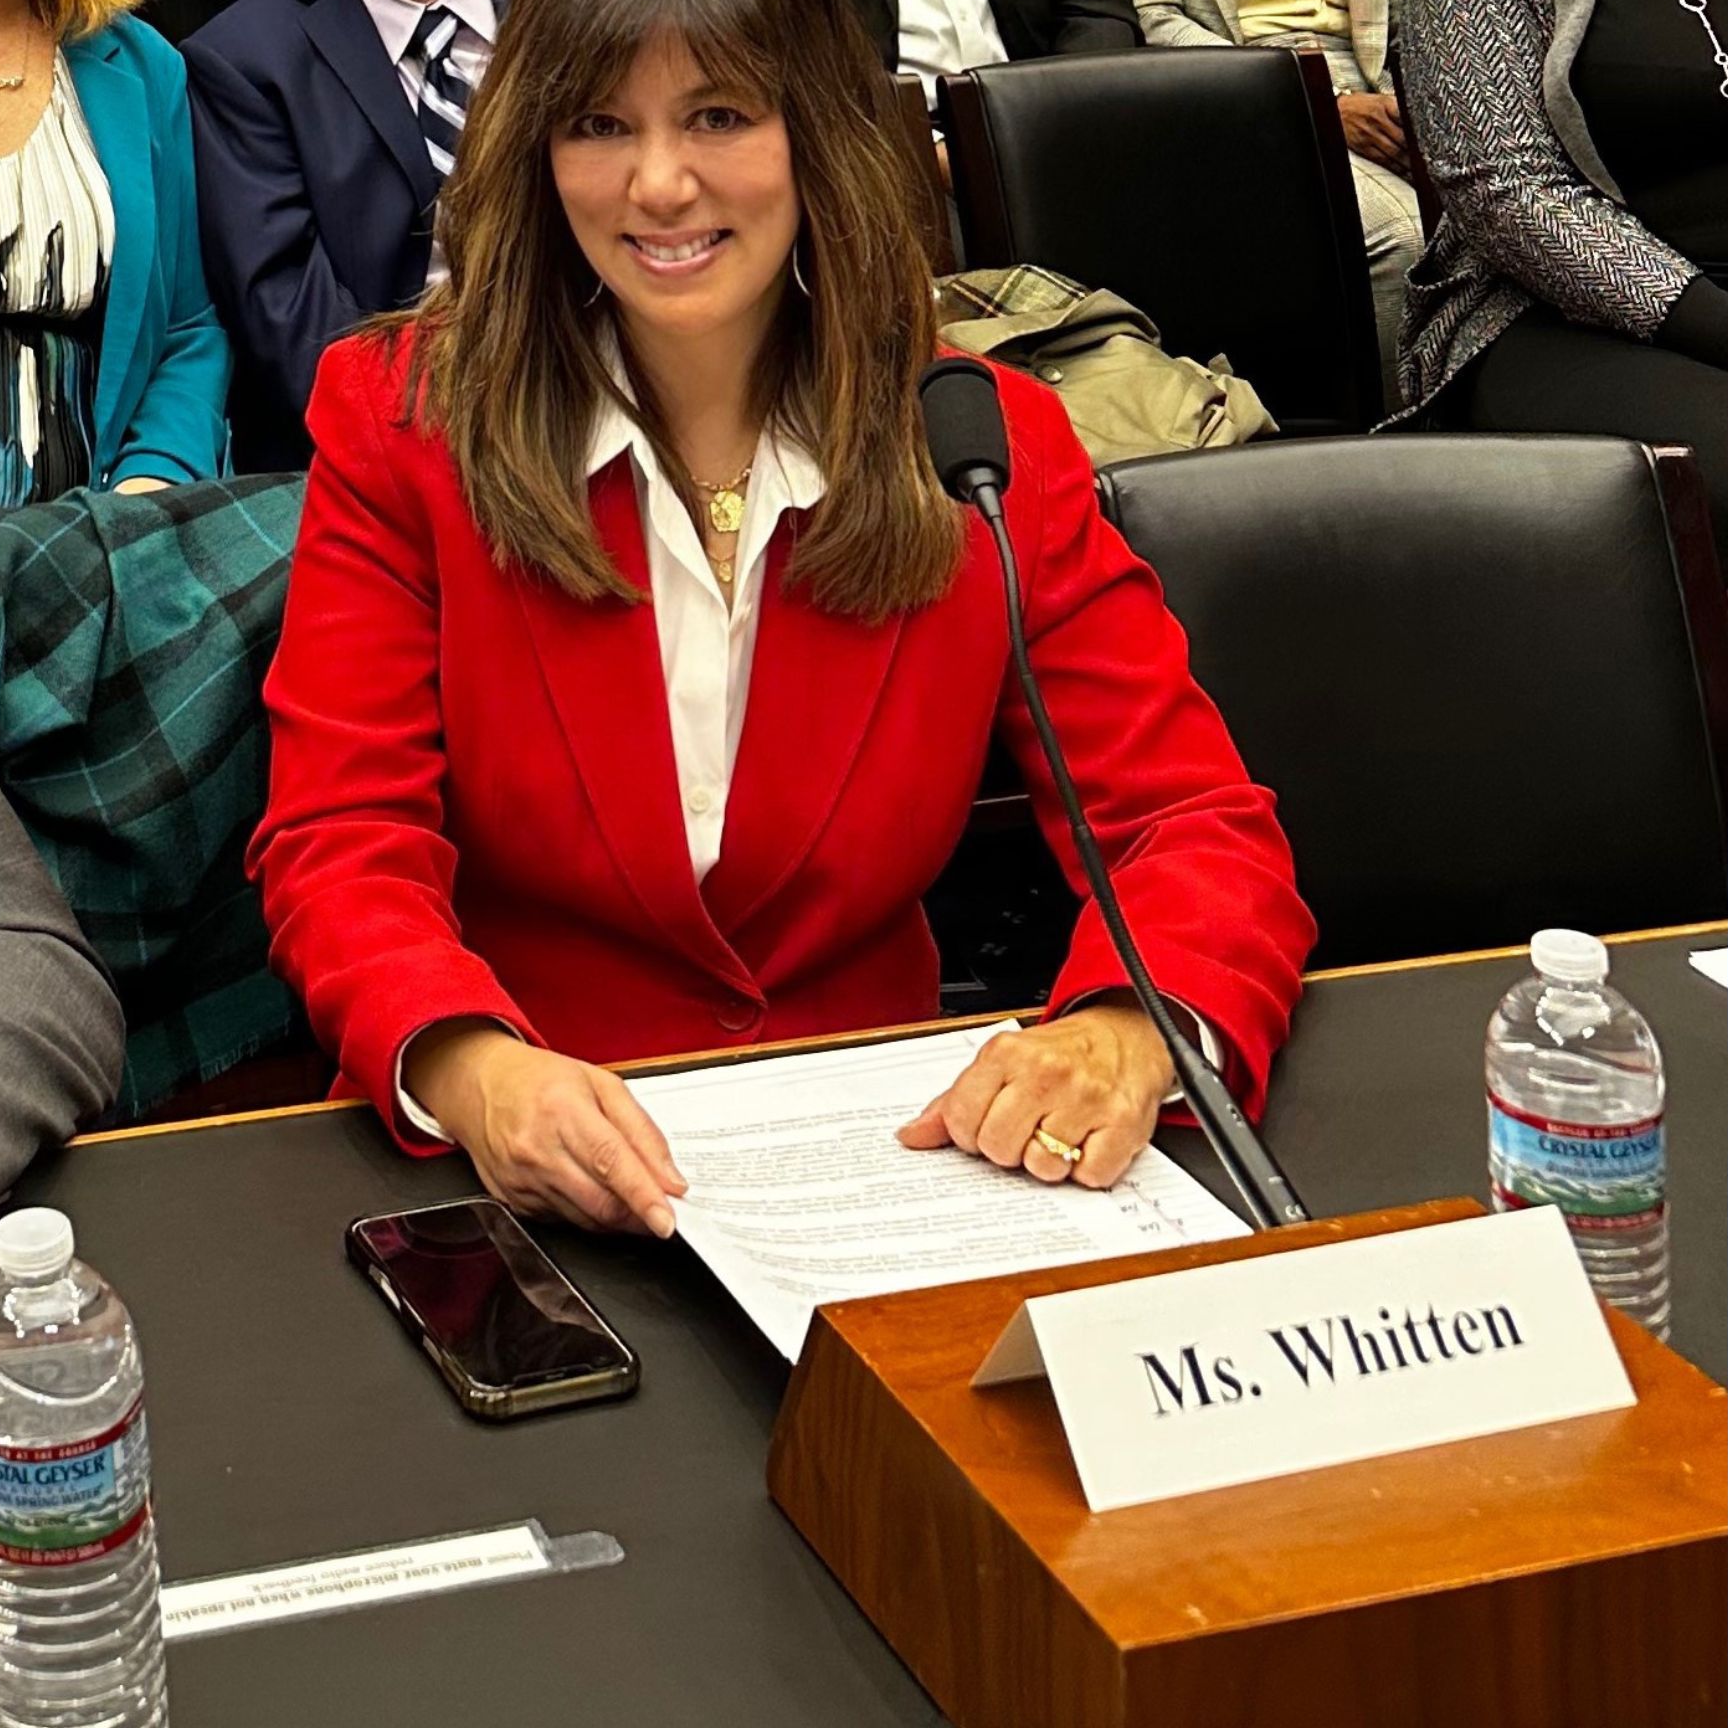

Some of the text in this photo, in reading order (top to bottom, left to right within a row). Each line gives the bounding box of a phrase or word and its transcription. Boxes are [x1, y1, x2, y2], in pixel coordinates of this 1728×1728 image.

[1135, 1303, 1527, 1419] Ms. Whitten
[34, 1450, 107, 1486] GEYSER
